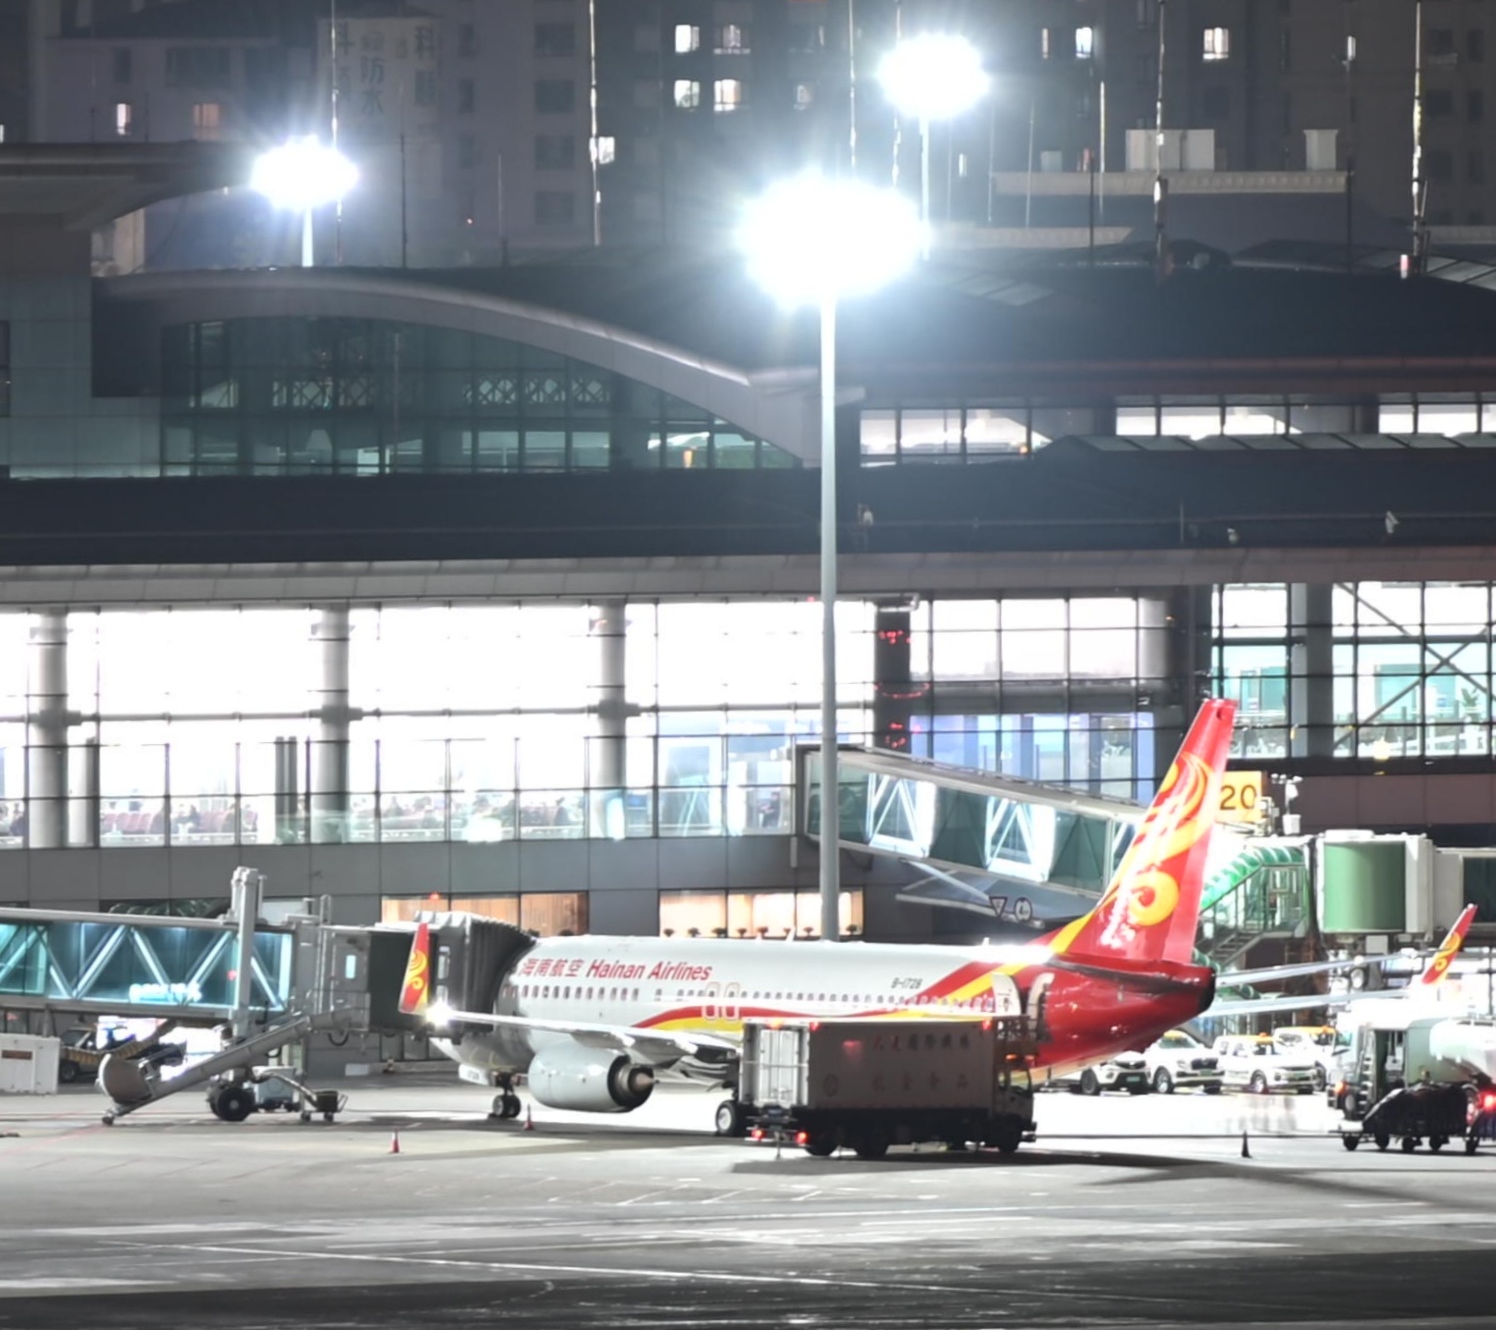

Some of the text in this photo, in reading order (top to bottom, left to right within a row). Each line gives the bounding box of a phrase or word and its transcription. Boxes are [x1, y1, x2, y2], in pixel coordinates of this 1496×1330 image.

[360, 54, 385, 116] 防水
[1220, 784, 1257, 810] 20
[519, 958, 713, 981] 海南航空 Hainan Airlines
